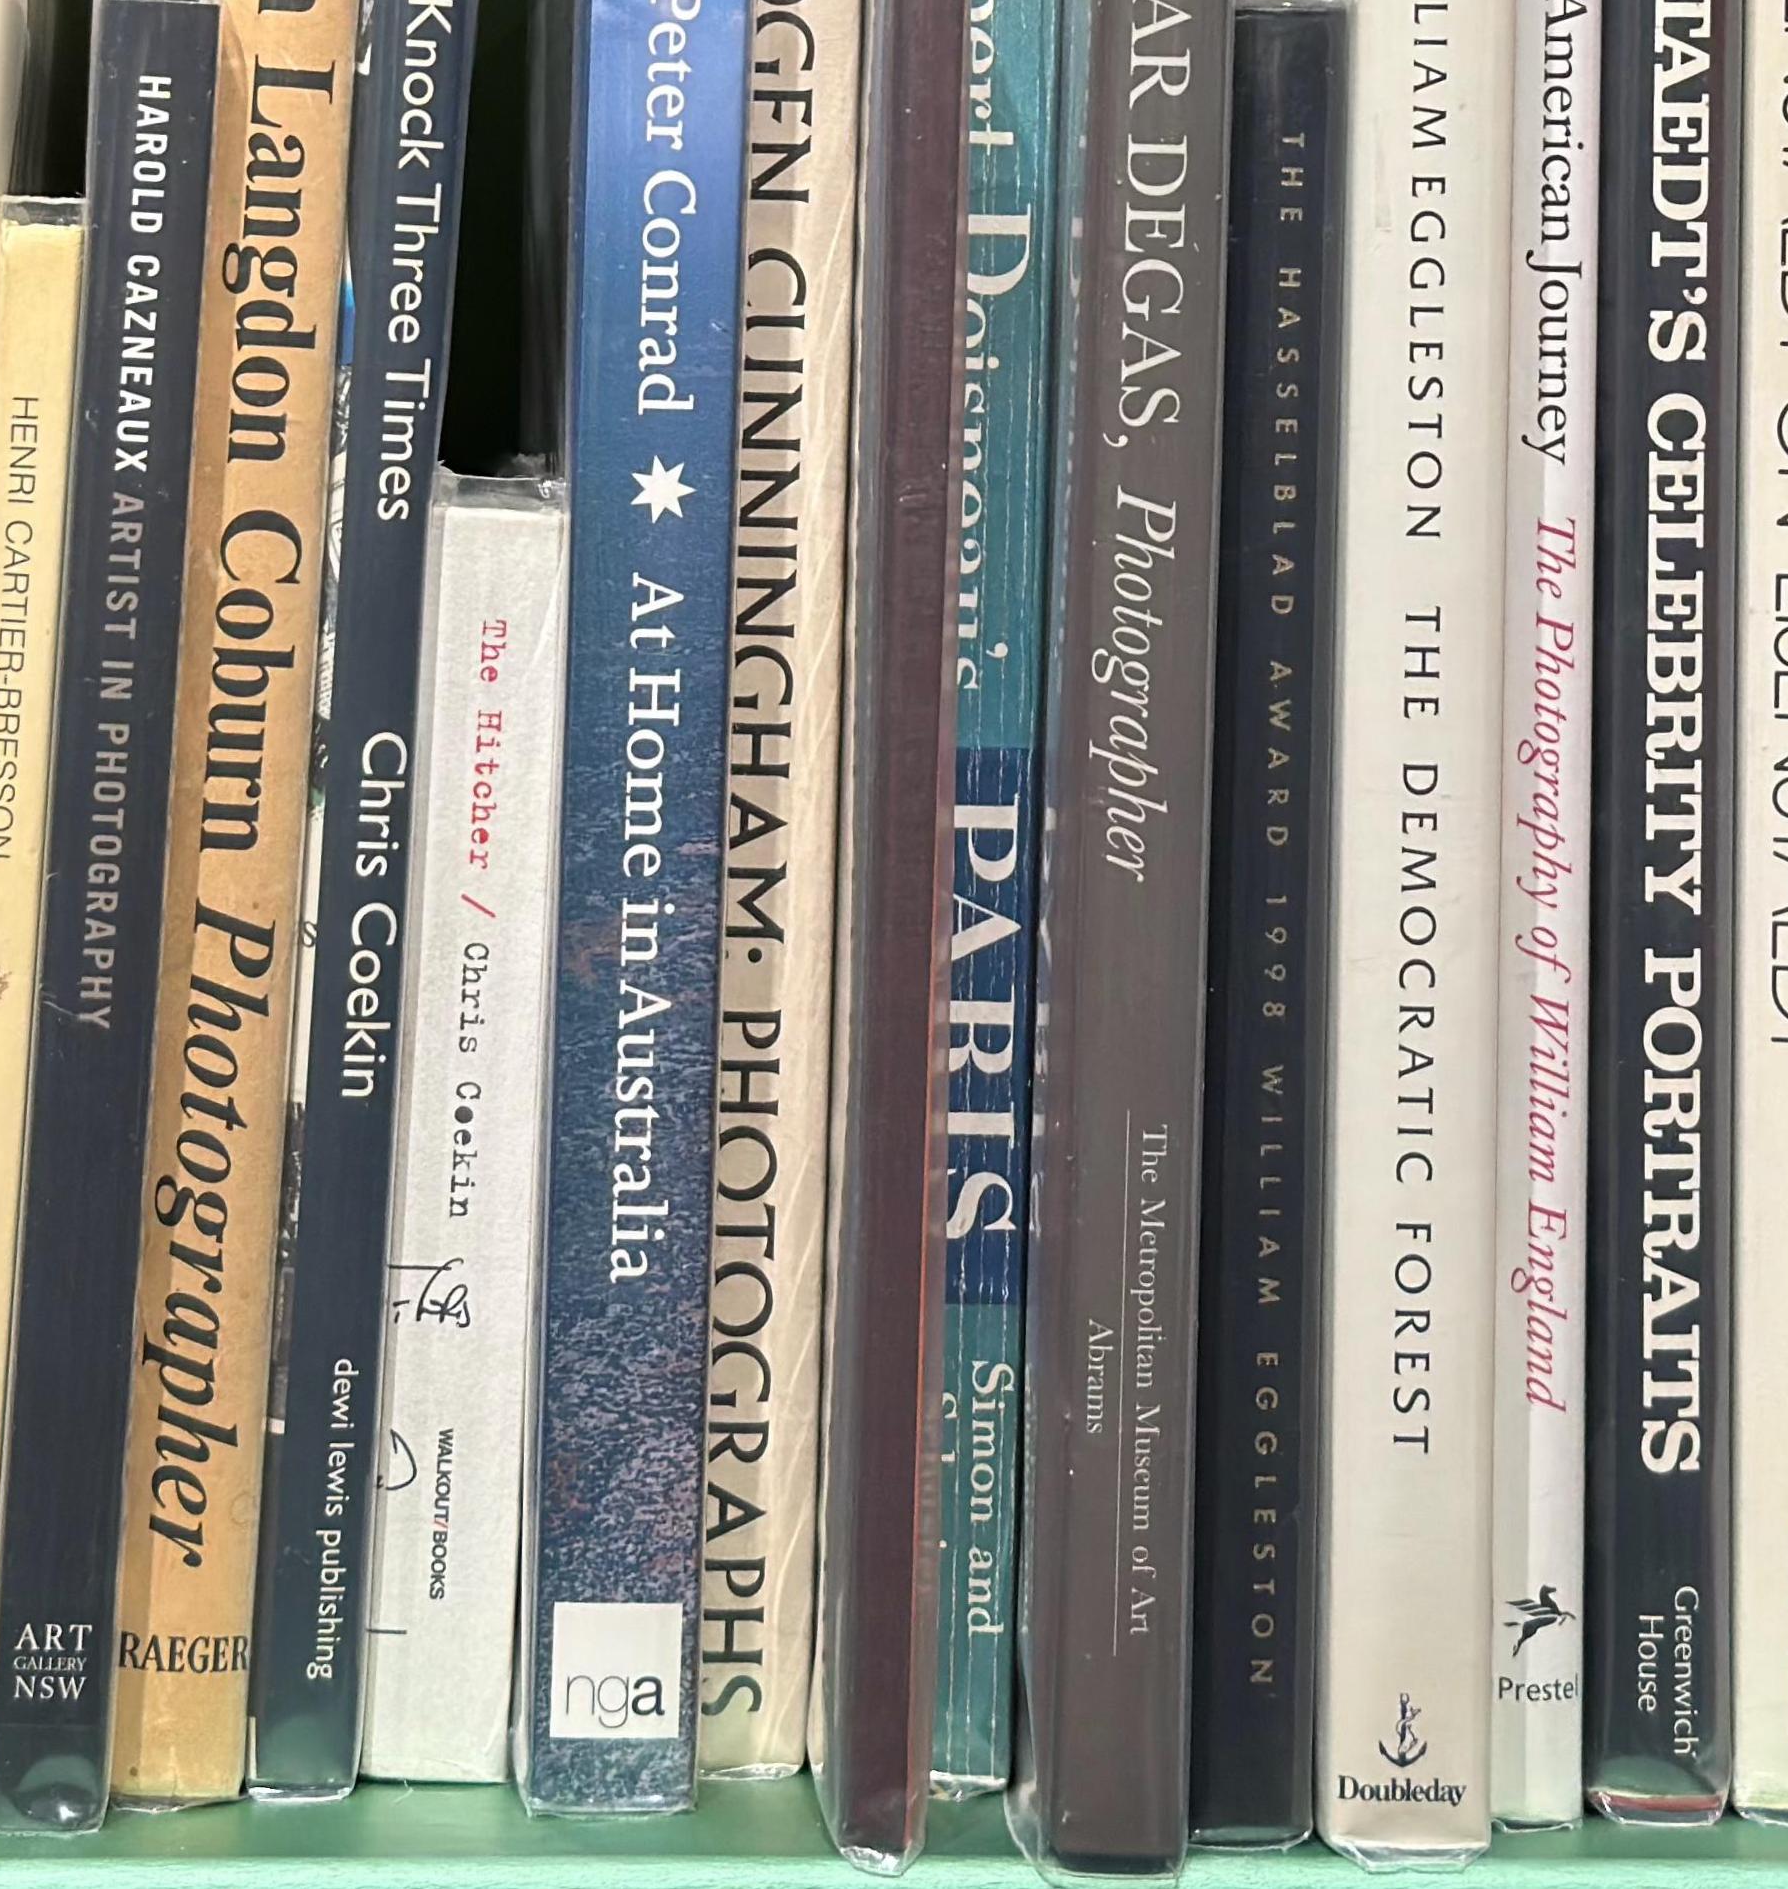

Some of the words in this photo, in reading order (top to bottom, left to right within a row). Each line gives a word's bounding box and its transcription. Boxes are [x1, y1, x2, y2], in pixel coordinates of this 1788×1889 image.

[129, 75, 172, 233] HAROLD
[1279, 132, 1305, 222] THE
[222, 56, 335, 465] Langdon
[114, 255, 164, 473] CAZNEAUX
[1521, 250, 1582, 465] Journey
[7, 396, 38, 504] HENRI
[1270, 267, 1302, 614] HASSELBLAD
[102, 492, 142, 635] ARTIST
[1534, 516, 1576, 595] The
[100, 661, 133, 700] IN
[198, 511, 303, 853] Coburn
[479, 619, 508, 682] The
[468, 711, 503, 869] Hitcher
[1267, 661, 1292, 846] AWARD
[1515, 611, 1575, 910] Photography
[77, 723, 128, 1028] PHOTOGRAPHY
[456, 942, 490, 1053] Chris
[946, 792, 1022, 1239] PARIS
[1263, 896, 1289, 1018] 1998
[1514, 927, 1572, 983] of
[449, 1081, 482, 1218] Coekin
[1528, 994, 1571, 1184] William
[1140, 1124, 1168, 1183] The
[1257, 1064, 1286, 1304] WILLIAM
[143, 899, 277, 1568] Photographer
[1134, 1198, 1167, 1389] Metropolitan
[1511, 1200, 1568, 1414] England
[329, 1359, 359, 1429] dewi
[1086, 1319, 1113, 1434] Abrams
[324, 1443, 355, 1516] lewis
[968, 1361, 1014, 1522] Simon
[1131, 1404, 1160, 1531] Museum
[1130, 1545, 1157, 1579] of
[1250, 1352, 1279, 1683] EGGLESTON
[15, 1624, 92, 1652] ART
[306, 1530, 347, 1678] publishing
[966, 1547, 1005, 1638] and
[1130, 1586, 1156, 1635] Art
[13, 1675, 88, 1701] NSW
[14, 1655, 87, 1671] GALLERY
[564, 1673, 666, 1729] nga
[1497, 1676, 1579, 1700] Prestel
[1635, 1614, 1664, 1713] House
[1670, 1586, 1700, 1754] Greenwich
[1336, 1775, 1467, 1807] Doubleday
